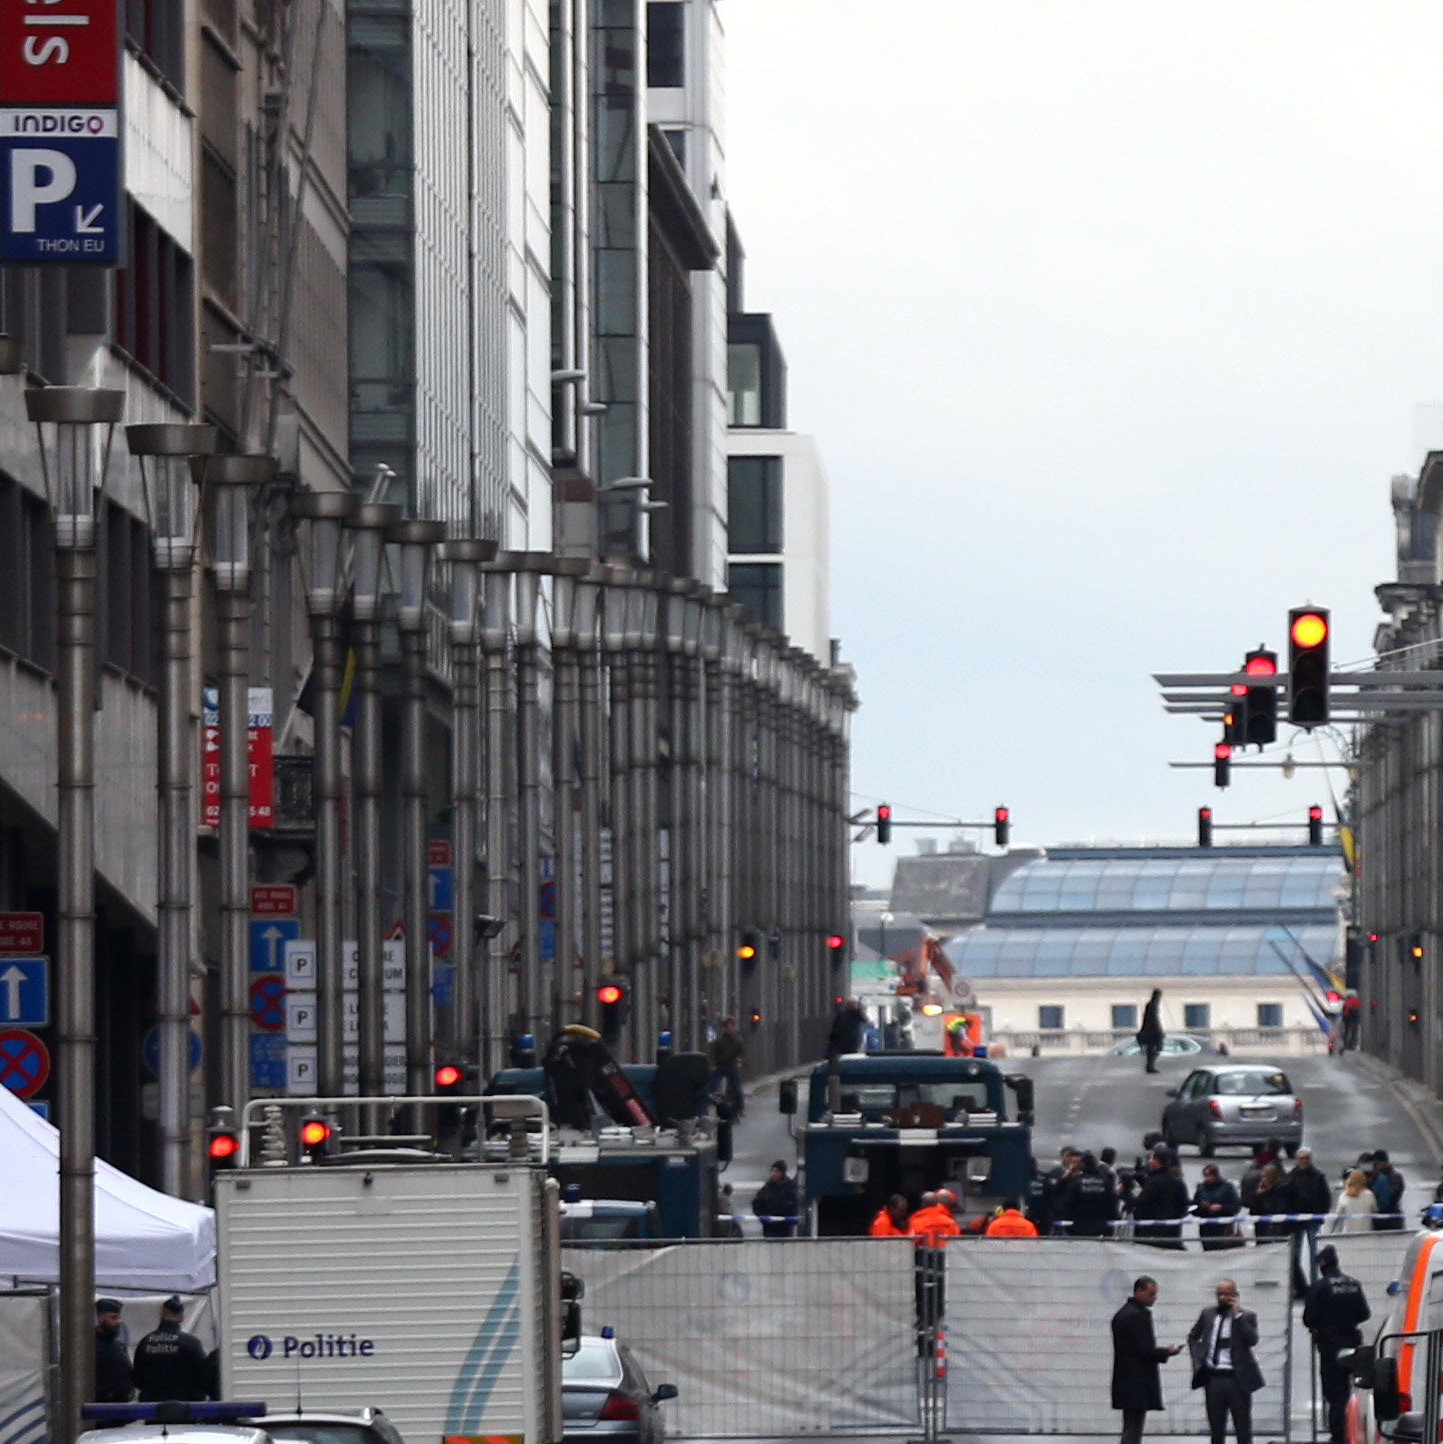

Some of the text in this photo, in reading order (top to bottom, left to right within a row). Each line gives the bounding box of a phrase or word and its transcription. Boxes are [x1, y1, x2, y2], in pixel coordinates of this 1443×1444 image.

[24, 0, 90, 65] ls
[14, 115, 104, 134] INDIGO
[12, 149, 77, 233] P
[37, 239, 105, 252] THON EU
[297, 958, 308, 972] P
[297, 1011, 308, 1024] P
[298, 1064, 309, 1077] P
[146, 1343, 179, 1353] Politie
[283, 1333, 374, 1358] Politie
